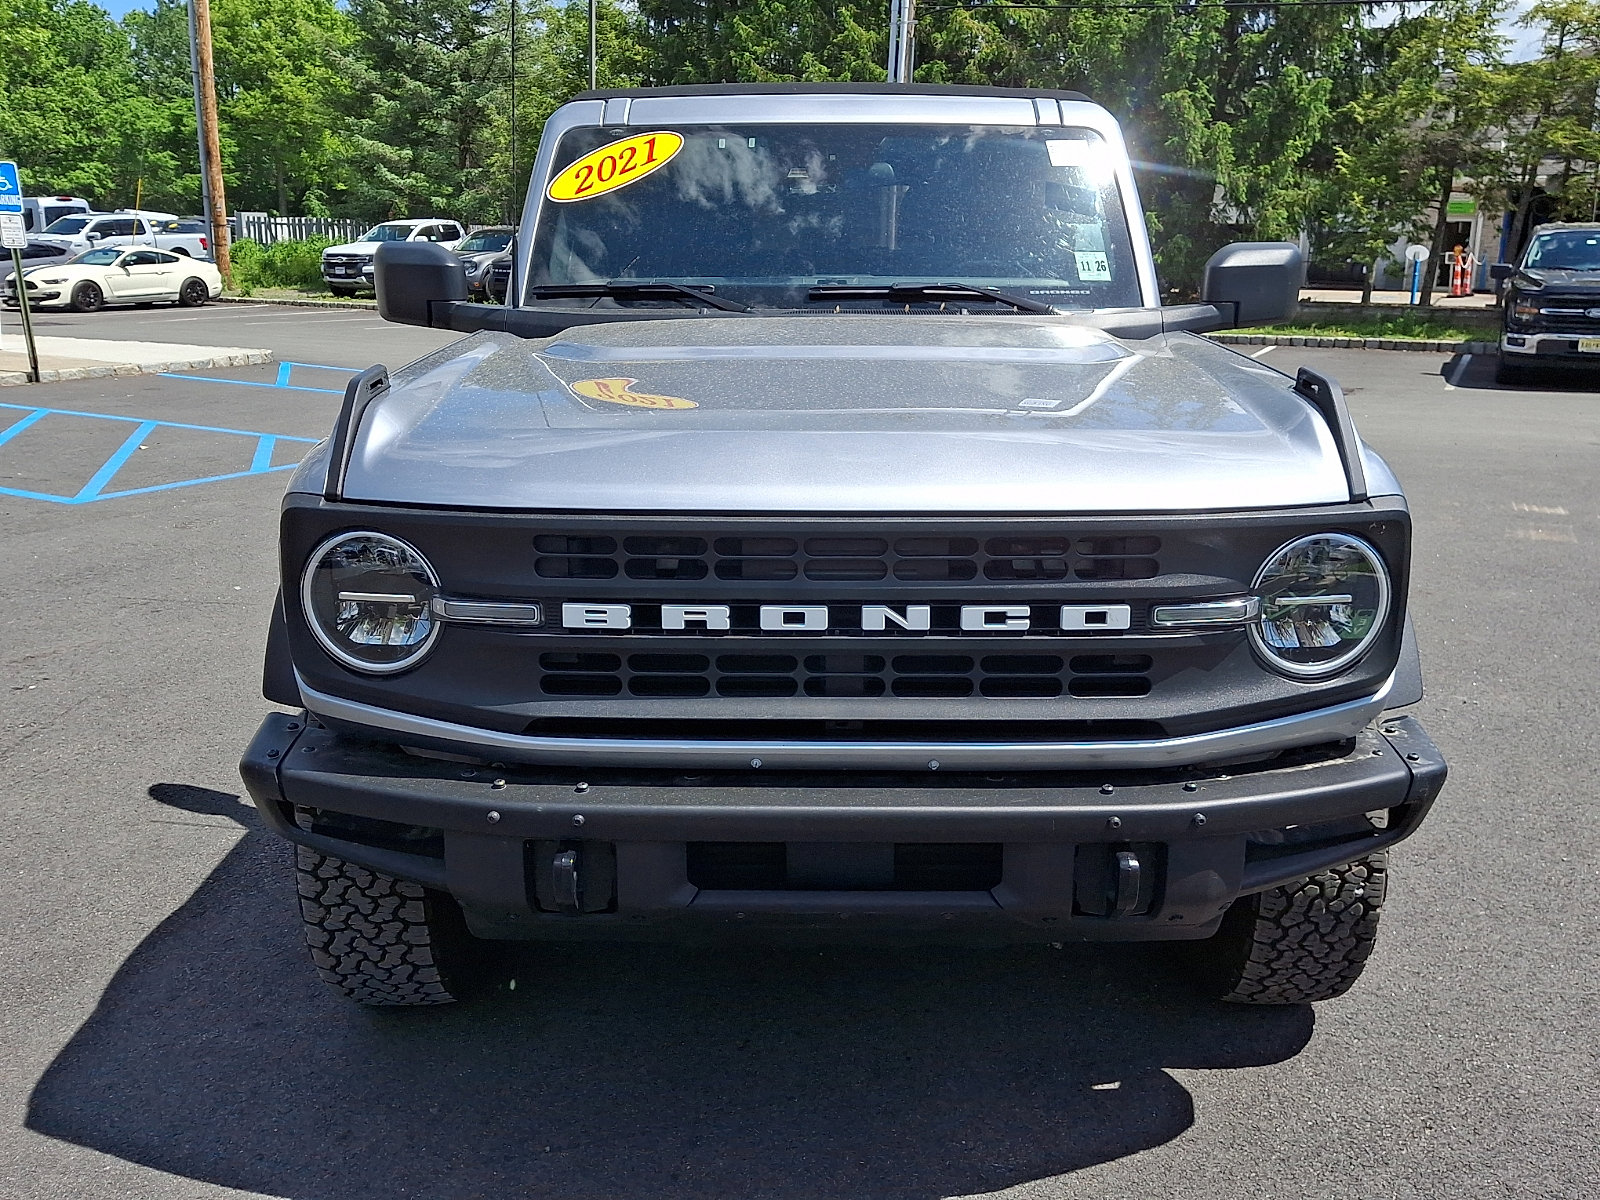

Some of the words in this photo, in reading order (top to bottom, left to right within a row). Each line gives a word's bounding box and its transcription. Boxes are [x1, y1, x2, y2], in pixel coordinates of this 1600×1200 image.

[574, 137, 658, 195] 2021
[0, 194, 21, 206] RKING
[1080, 260, 1092, 272] 11
[1094, 260, 1107, 272] 26
[562, 602, 1132, 631] BRONCO
